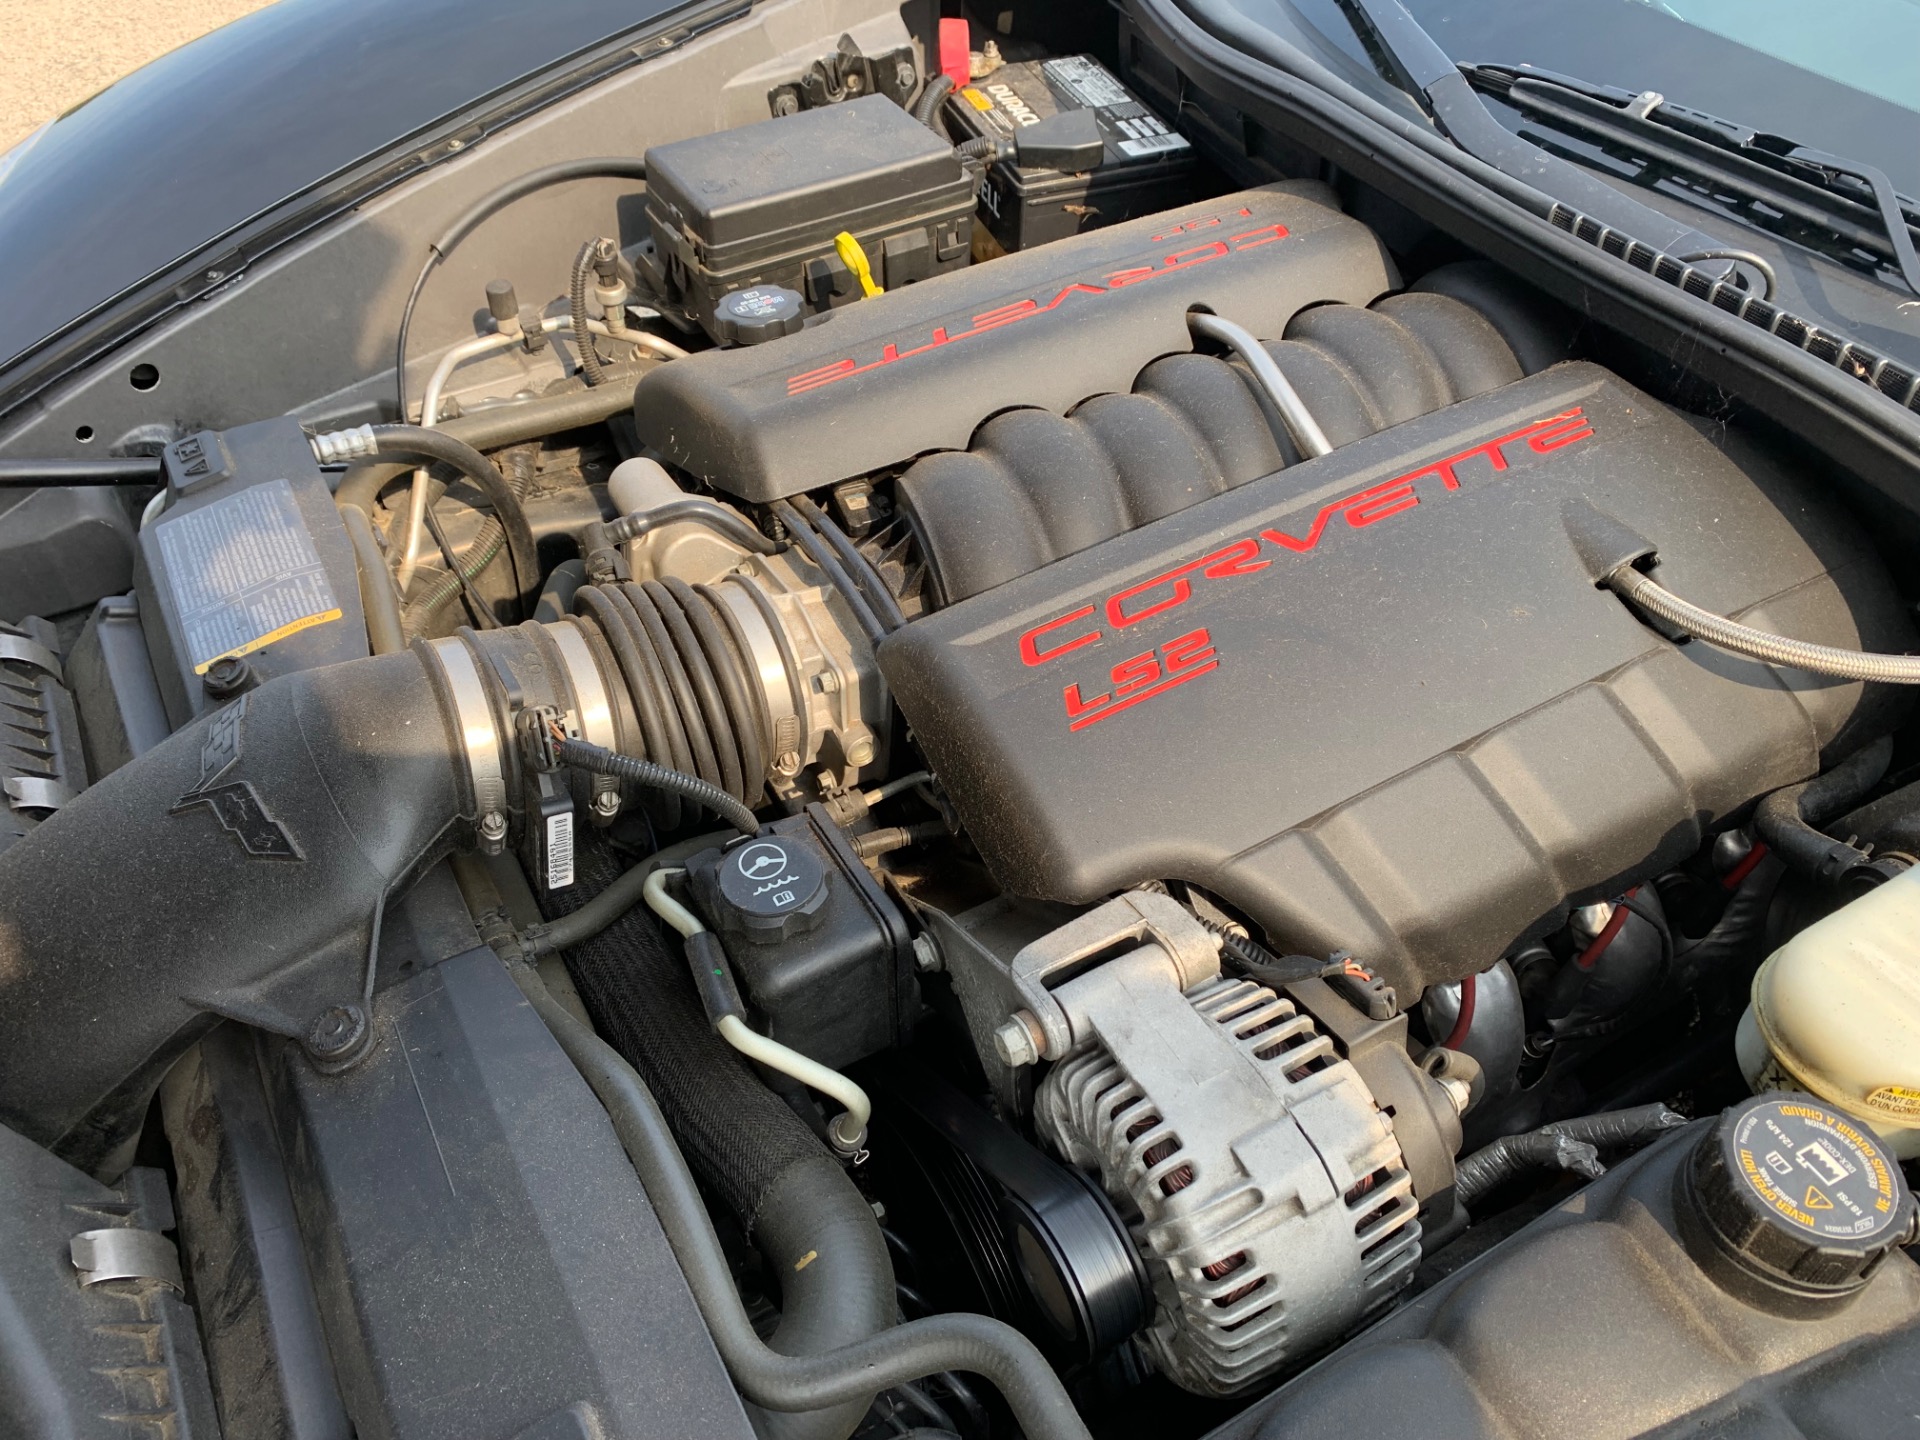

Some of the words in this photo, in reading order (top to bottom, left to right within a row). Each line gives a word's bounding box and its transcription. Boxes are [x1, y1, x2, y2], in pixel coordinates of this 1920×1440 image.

[977, 178, 1000, 219] ELL
[787, 224, 1290, 396] CORVETTE
[1019, 406, 1595, 666] CORVETTE
[1063, 628, 1217, 717] LS2
[1870, 1098, 1892, 1110] D'UN
[1874, 1091, 1905, 1104] AVANT
[1905, 1098, 1919, 1107] DE
[1778, 1105, 1824, 1121] CHAUD!
[1765, 1119, 1781, 1135] kPa
[1778, 1133, 1795, 1149] 124
[1836, 1121, 1876, 1157] OUVRIR
[1740, 1148, 1758, 1173] HOT!
[1750, 1174, 1778, 1201] OPEN
[1758, 1167, 1775, 1187] TANK
[1871, 1158, 1892, 1198] JAMAIS
[1772, 1185, 1798, 1208] SURGE
[1836, 1191, 1853, 1207] PSI
[1875, 1196, 1891, 1213] NE
[1775, 1199, 1816, 1227] NEVER
[1850, 1204, 1863, 1216] 18
